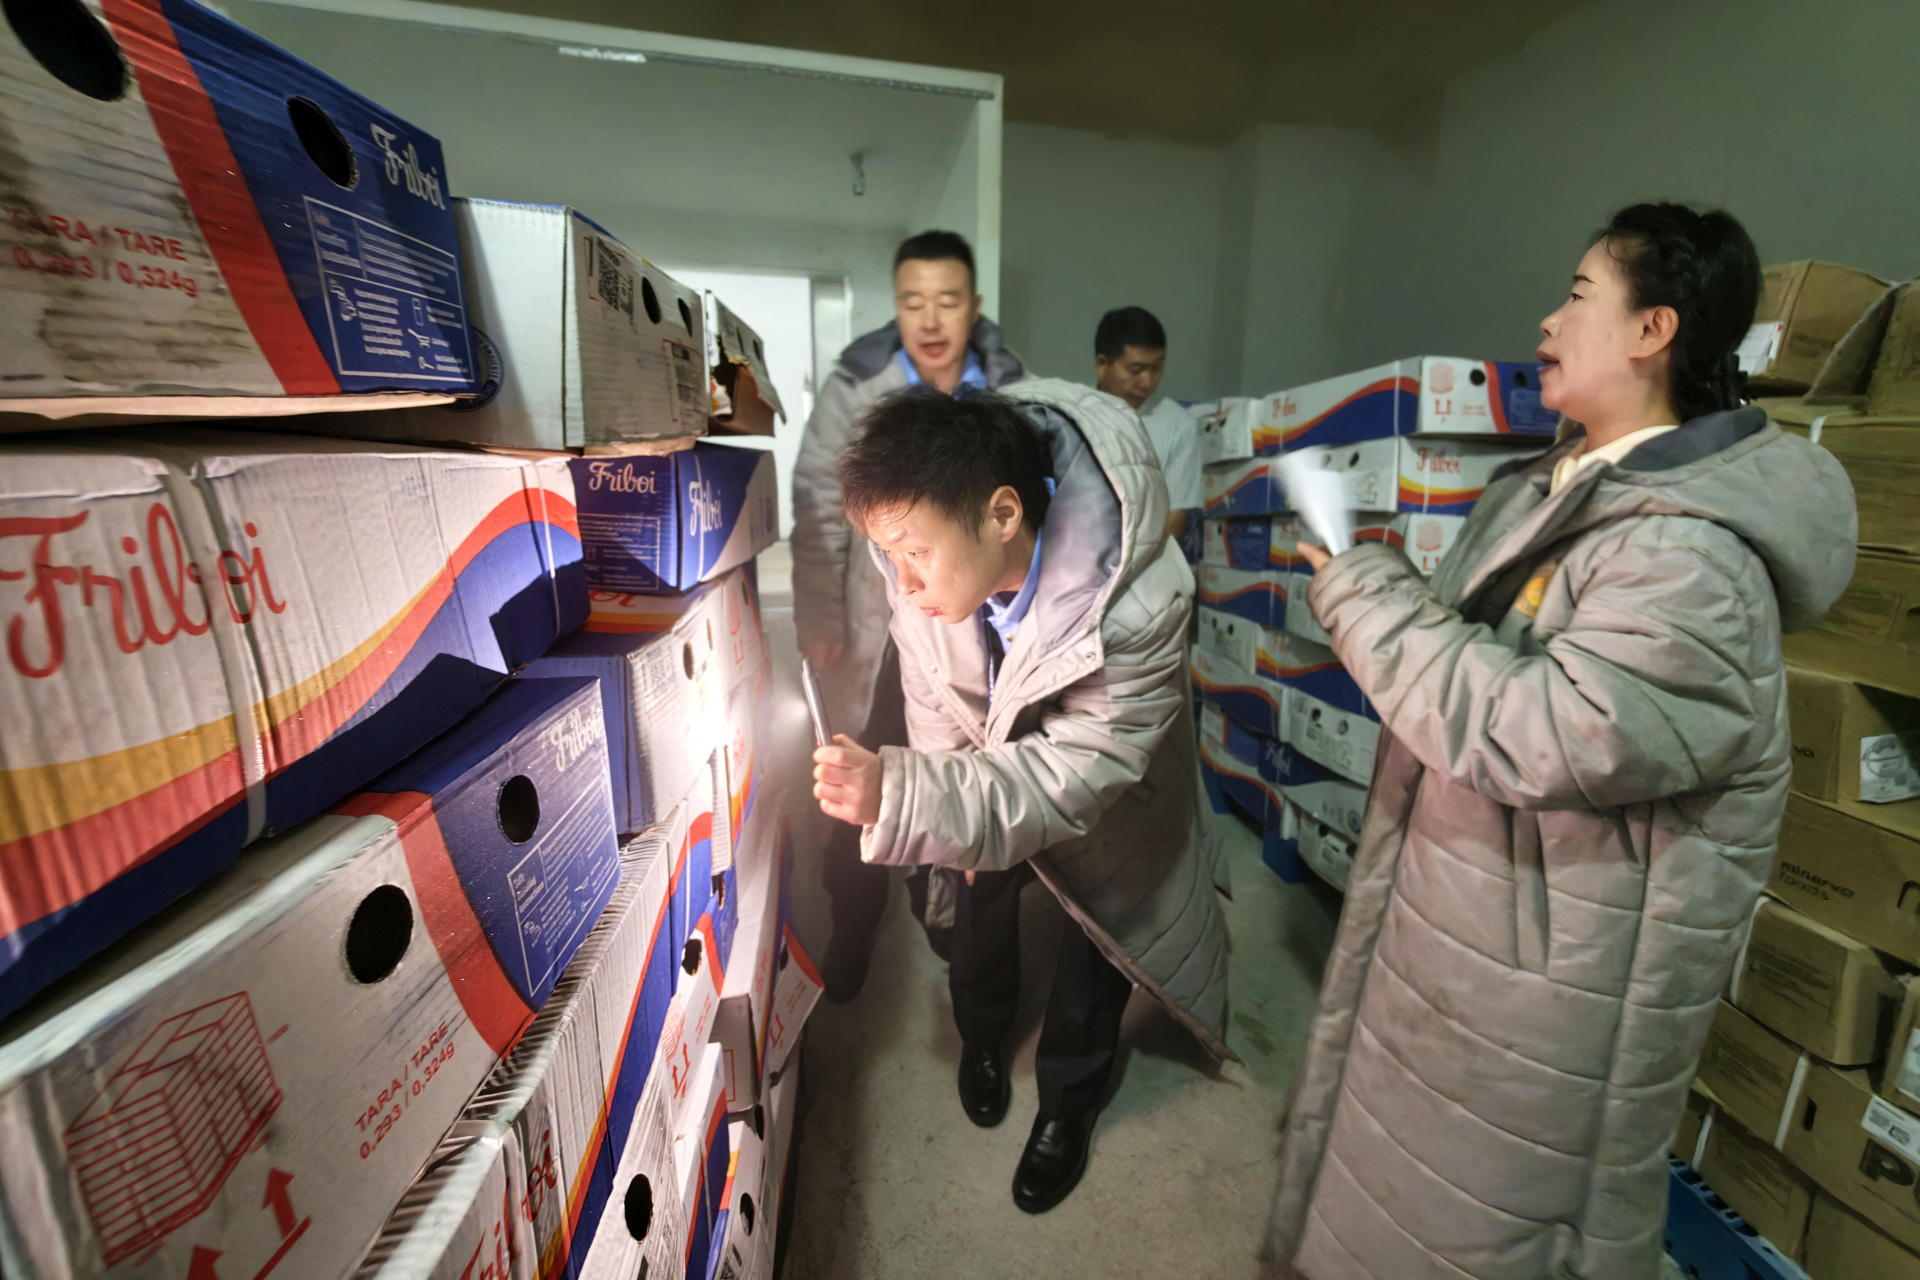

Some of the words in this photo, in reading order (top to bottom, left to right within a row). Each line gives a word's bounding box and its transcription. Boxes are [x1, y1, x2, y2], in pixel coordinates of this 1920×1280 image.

[369, 122, 446, 211] Friboi
[114, 227, 190, 263] TARE
[589, 461, 658, 495] Friboi
[0, 502, 287, 679] Friboi
[355, 1078, 403, 1133] TARA
[411, 1020, 448, 1069] TARE
